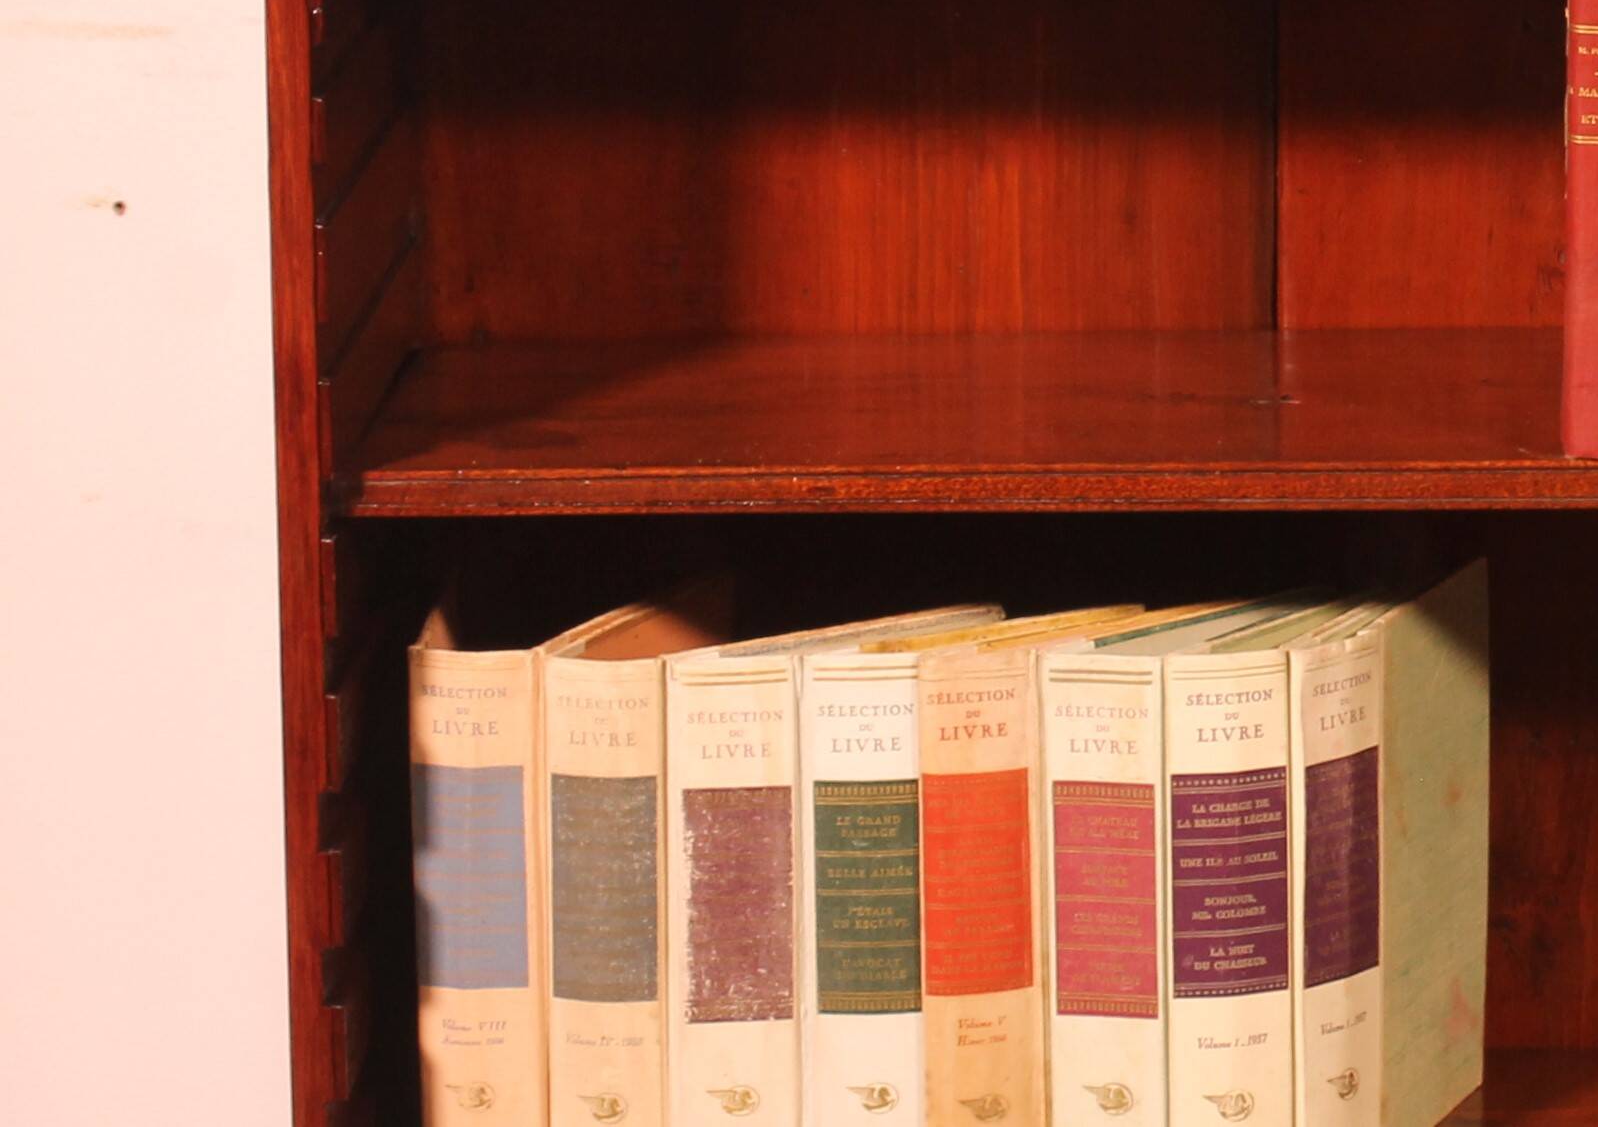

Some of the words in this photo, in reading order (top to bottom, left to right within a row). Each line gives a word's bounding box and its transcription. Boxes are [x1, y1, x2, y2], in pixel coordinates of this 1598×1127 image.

[926, 688, 1015, 707] SÉLECTION
[1185, 686, 1274, 707] SÉLECTION
[687, 709, 784, 726] SÉLECTION
[816, 702, 914, 718] SÉLECTION
[965, 709, 981, 720] DU
[1054, 702, 1149, 721] SÉLECTION
[1224, 711, 1240, 722] DU
[1319, 706, 1368, 732] LIVRE
[432, 720, 500, 737] LIVRE
[858, 723, 874, 734] DU
[939, 722, 1008, 743] LIVRE
[1196, 724, 1265, 744] LIVRE
[569, 730, 638, 748] LIVRE
[831, 737, 903, 755] LIVRE
[1069, 738, 1139, 756] LIVRE
[701, 743, 772, 761] LIVRE
[1191, 803, 1206, 814] LA
[1208, 799, 1254, 815] CHARGE
[1255, 796, 1270, 810] DE
[1176, 817, 1191, 830] LA
[1193, 814, 1243, 830] BRIGADE
[1179, 857, 1204, 869] UNE
[1225, 855, 1242, 867] AU
[1243, 850, 1279, 866] SOLEIL
[1209, 946, 1225, 957] LA
[1194, 960, 1211, 971] DU
[1320, 1022, 1345, 1036] Volume
[1197, 1036, 1232, 1050] Volume
